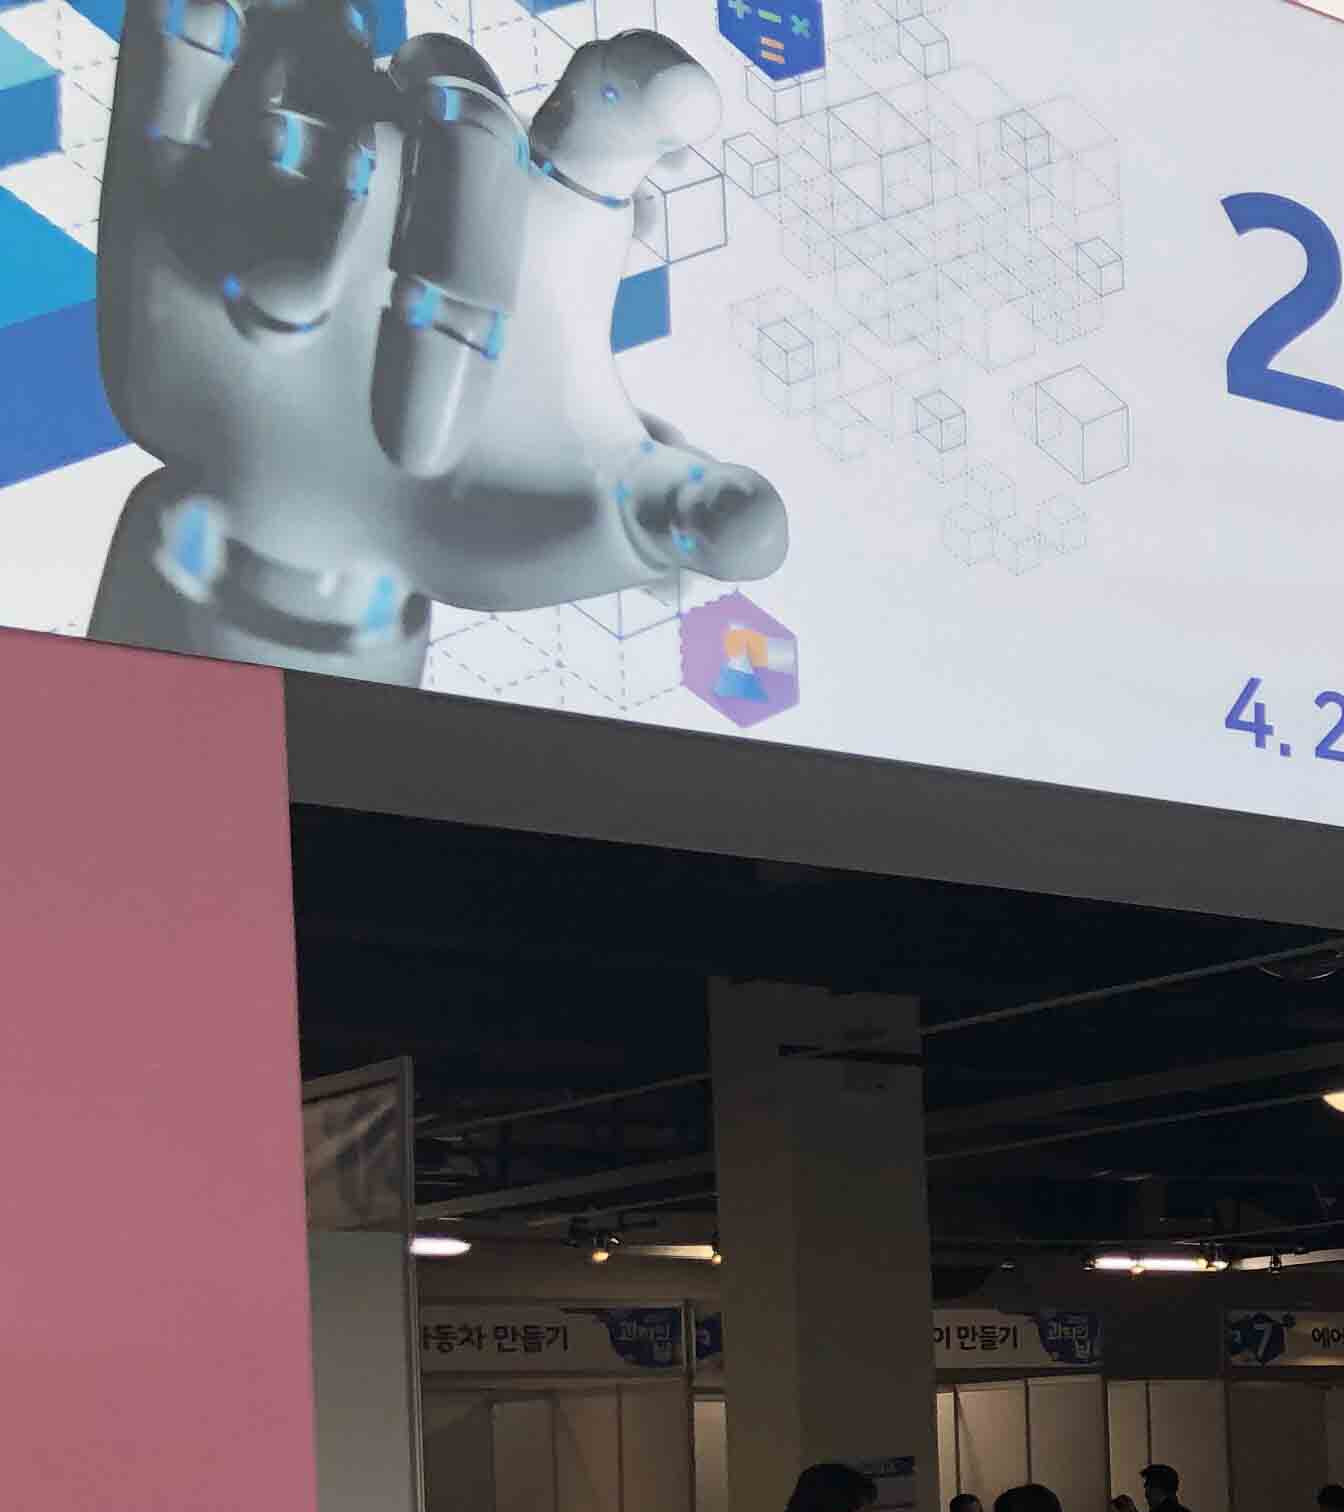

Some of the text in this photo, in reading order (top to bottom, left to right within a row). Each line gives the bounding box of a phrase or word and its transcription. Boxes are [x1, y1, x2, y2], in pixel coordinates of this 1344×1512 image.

[1225, 677, 1291, 757] 4.
[493, 1323, 568, 1352] 만들기
[955, 1322, 1019, 1351] 만들기
[1253, 1319, 1272, 1363] 7
